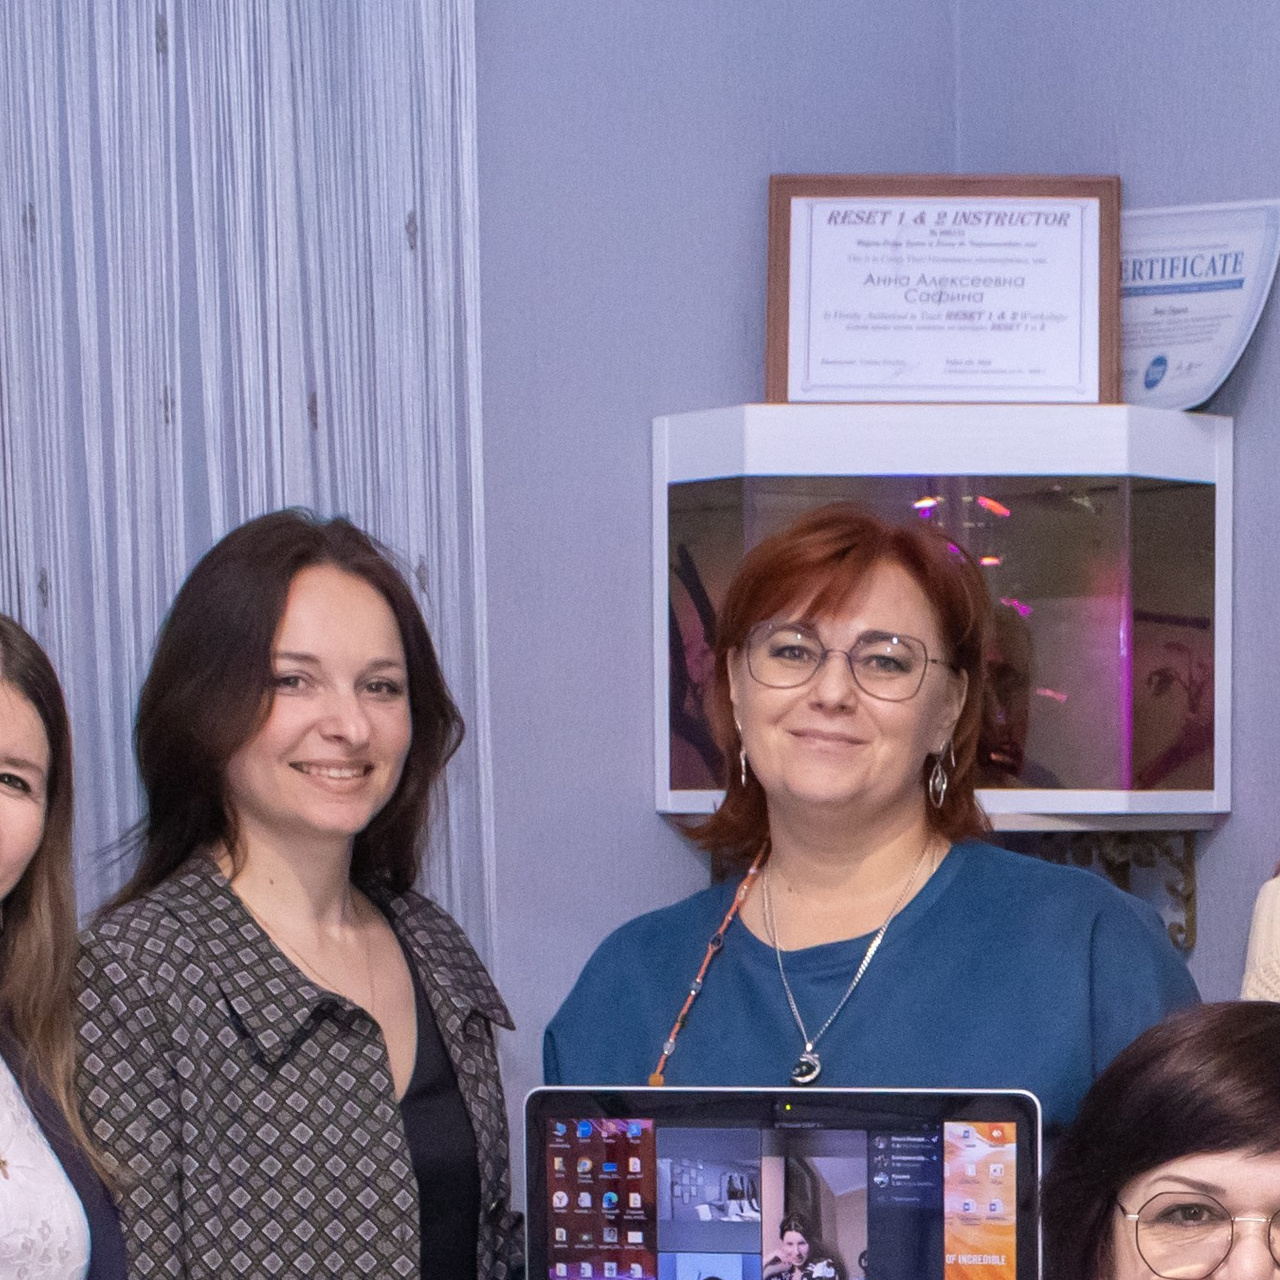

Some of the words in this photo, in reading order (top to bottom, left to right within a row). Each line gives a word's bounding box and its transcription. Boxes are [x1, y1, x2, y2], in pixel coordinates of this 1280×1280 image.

[827, 209, 892, 226] RESET
[898, 210, 906, 226] 1
[913, 210, 927, 225] &
[952, 210, 1071, 227] INSTRUCTOR
[1120, 251, 1245, 281] ERTIFICATE
[863, 272, 911, 287] Анна
[916, 272, 1026, 288] Алексеевна
[904, 288, 984, 306] Сафина
[945, 1254, 956, 1264] OF
[958, 1254, 1006, 1266] INCREDIBLE
